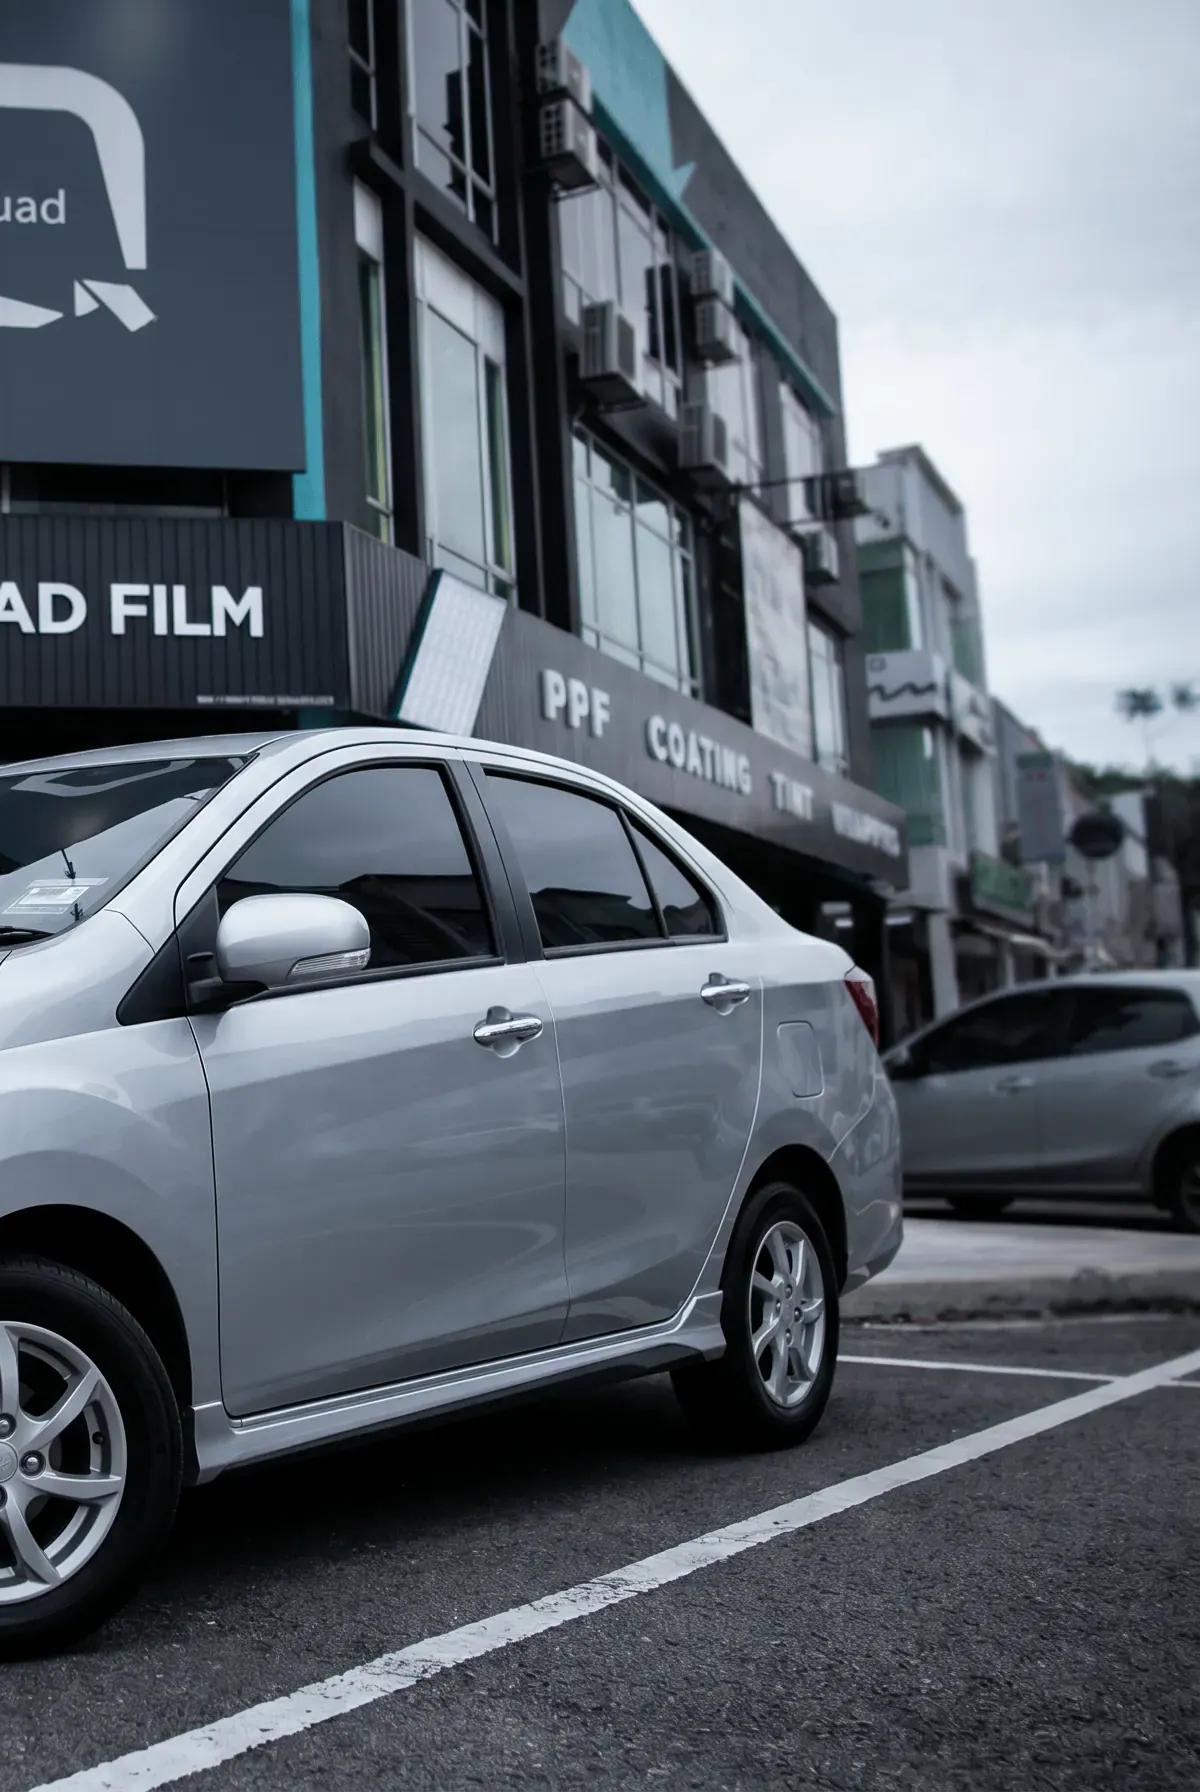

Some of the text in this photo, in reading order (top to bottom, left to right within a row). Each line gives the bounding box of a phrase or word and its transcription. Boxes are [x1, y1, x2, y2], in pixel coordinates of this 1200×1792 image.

[109, 582, 265, 639] FILM
[541, 668, 611, 738] PPF
[647, 714, 752, 796] COATING
